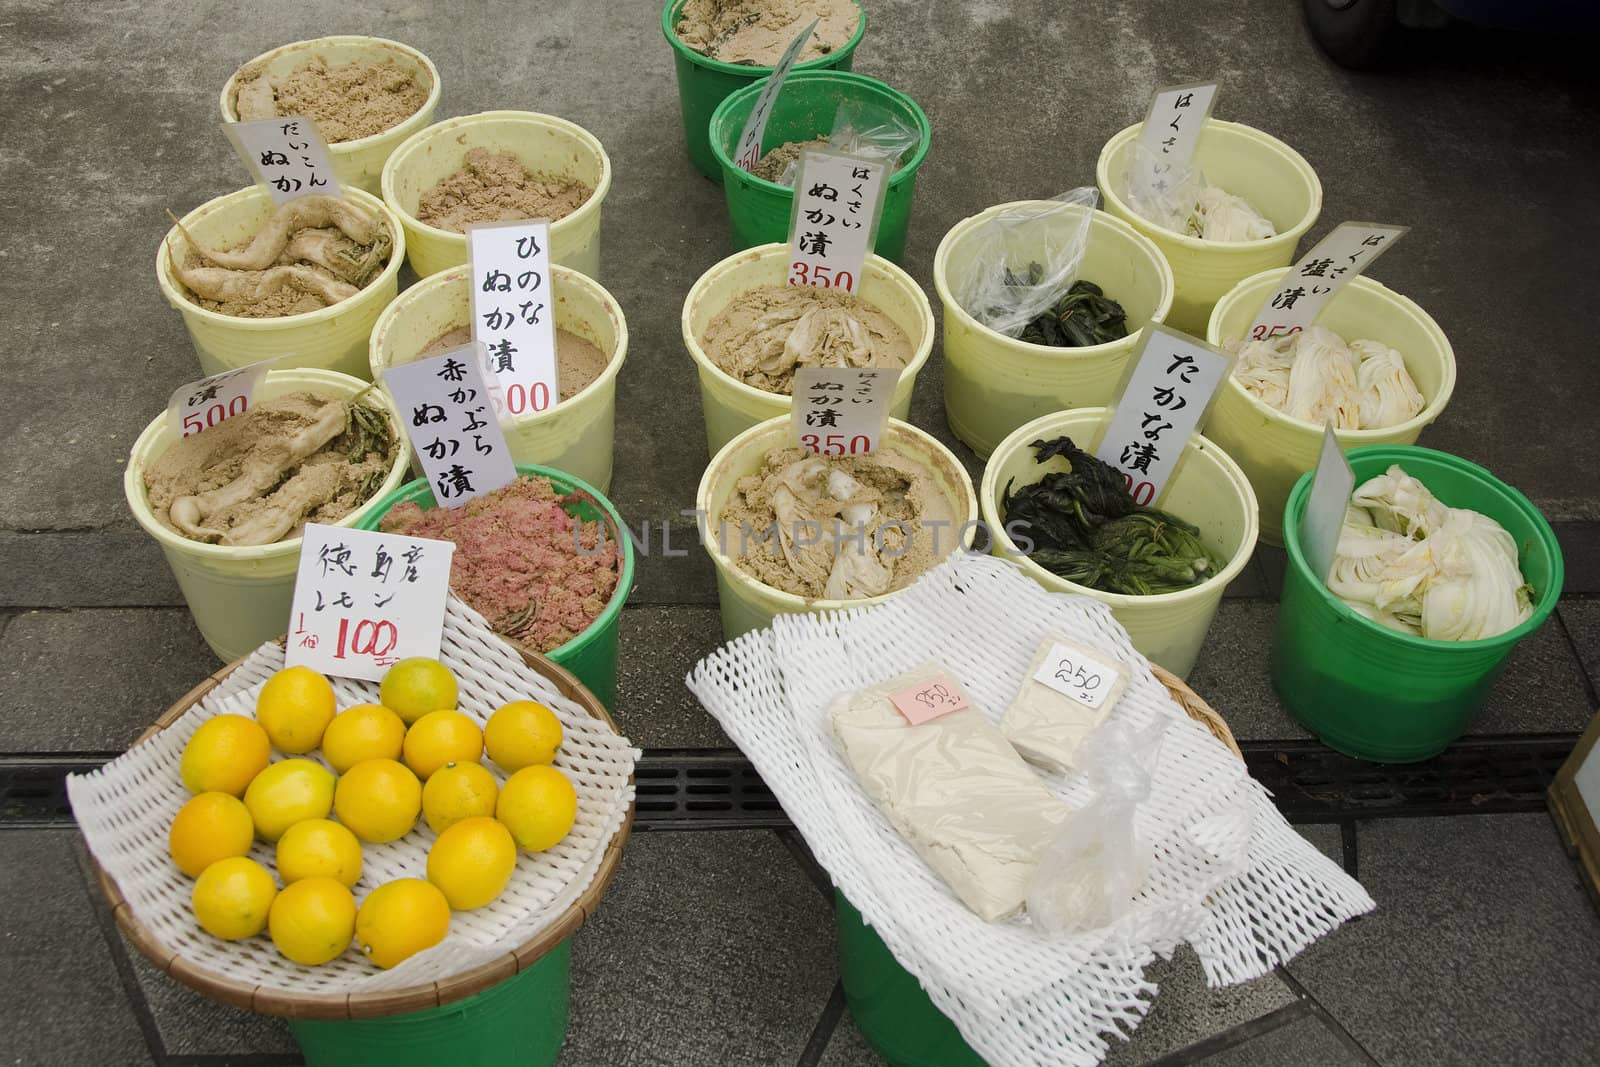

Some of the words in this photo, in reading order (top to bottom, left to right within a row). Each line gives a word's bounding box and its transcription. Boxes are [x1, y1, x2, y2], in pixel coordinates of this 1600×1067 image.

[280, 121, 327, 187] だいこん
[799, 182, 839, 258] ぬか漬
[842, 167, 871, 229] はくさい
[515, 235, 544, 326] ひのな
[789, 261, 854, 293] 350
[1271, 258, 1335, 310] 塩漬
[1312, 234, 1385, 295] はくさい
[482, 269, 519, 374] ぬか漬
[806, 382, 845, 428] ぬか漬
[851, 372, 879, 404] はくさい
[183, 395, 248, 438] 500
[1120, 353, 1200, 476] たかな漬
[412, 403, 476, 499] ぬか漬
[801, 433, 871, 457] 350
[314, 590, 397, 612] レモン
[333, 617, 398, 660] 100
[1055, 659, 1101, 690] 250
